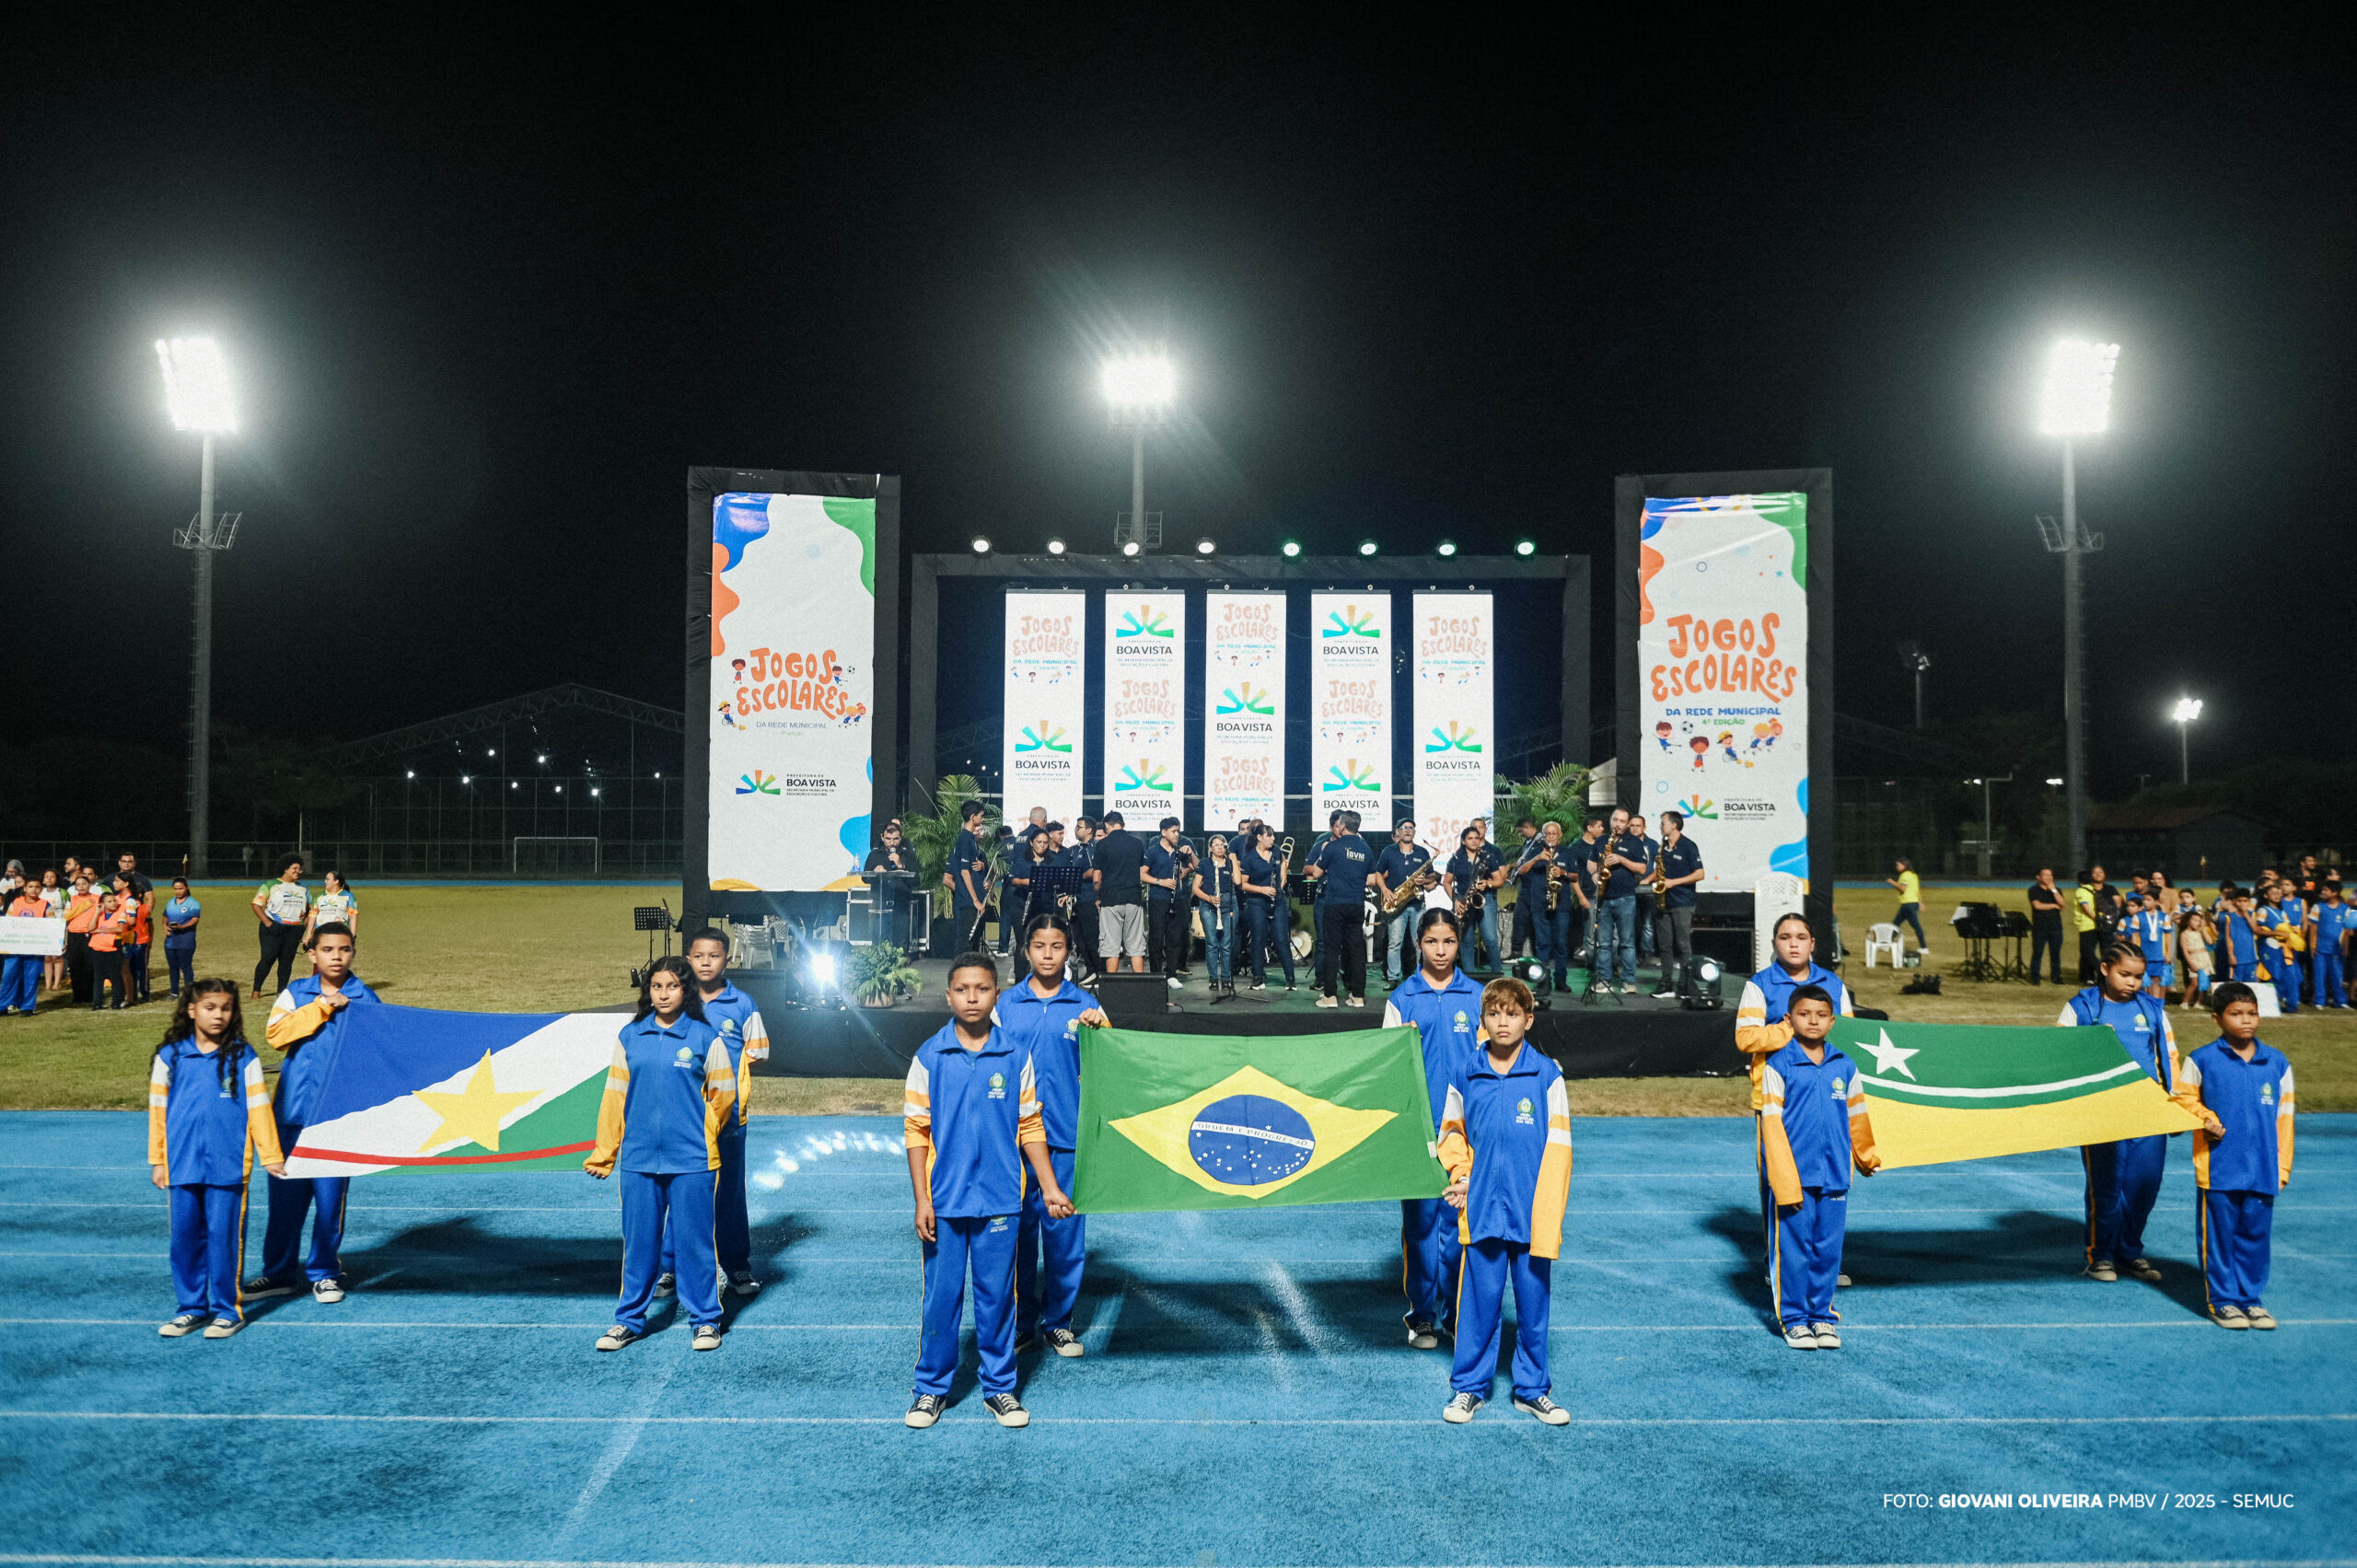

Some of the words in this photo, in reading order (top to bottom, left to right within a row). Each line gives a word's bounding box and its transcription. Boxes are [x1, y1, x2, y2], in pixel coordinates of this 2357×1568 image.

[1224, 604, 1271, 622] JOGOS
[1021, 616, 1072, 636] JOGOS
[1216, 621, 1278, 644] ESCOLARES
[1429, 616, 1479, 637] JOGOS
[1667, 612, 1780, 658] JOGOS
[1013, 635, 1079, 658] ESCOLARES
[1117, 646, 1140, 654] BOA
[1142, 646, 1172, 654] VISTA
[1348, 647, 1378, 655] VISTA
[1422, 635, 1487, 659] ESCOLARES
[749, 647, 836, 685] JOGOS
[1122, 679, 1169, 698] JOGOS
[1329, 679, 1376, 698] JOGOS
[1651, 653, 1797, 704] ESCOLARES
[737, 679, 848, 720] ESCOLARES
[1115, 697, 1176, 718] ESCOLARES
[1322, 697, 1383, 718] ESCOLARES
[1718, 707, 1781, 715] MUNICIPAL
[1217, 723, 1240, 731] BOA
[1242, 723, 1272, 731] VISTA
[1016, 760, 1039, 768] BOA
[1040, 761, 1070, 769] VISTA
[1221, 756, 1269, 776] JOGOS
[1426, 761, 1449, 769] BOA
[1451, 761, 1481, 769] VISTA
[1214, 775, 1275, 796] ESCOLARES
[1141, 800, 1171, 808] VISTA
[1324, 800, 1347, 808] BOA
[1349, 800, 1379, 808] VISTA
[1429, 817, 1469, 837] JOG
